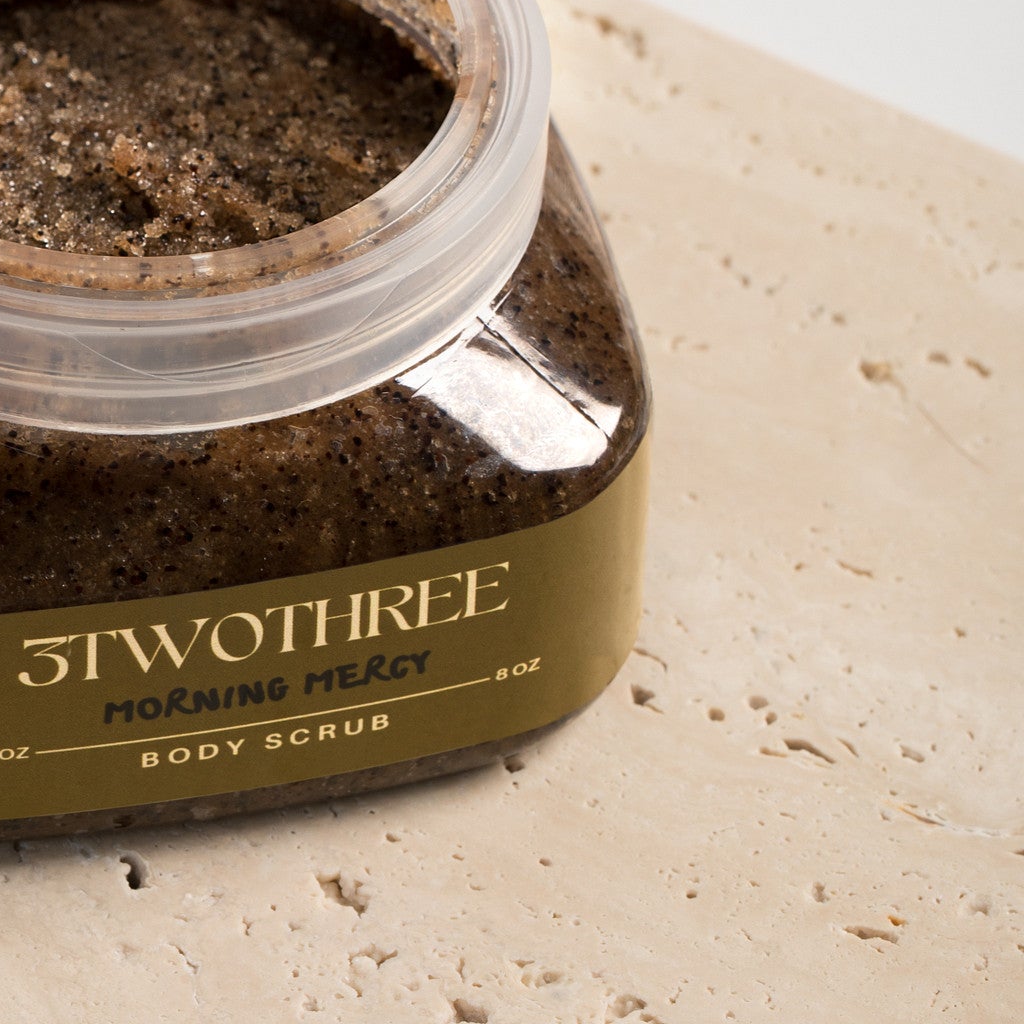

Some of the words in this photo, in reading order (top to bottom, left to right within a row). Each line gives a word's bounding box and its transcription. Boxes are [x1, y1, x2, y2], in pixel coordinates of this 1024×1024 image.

[18, 561, 510, 687] 3TWOTHREE
[103, 677, 287, 724] MORNING
[303, 650, 431, 696] MERCY
[141, 739, 246, 769] BODY
[264, 714, 391, 751] SCRUB
